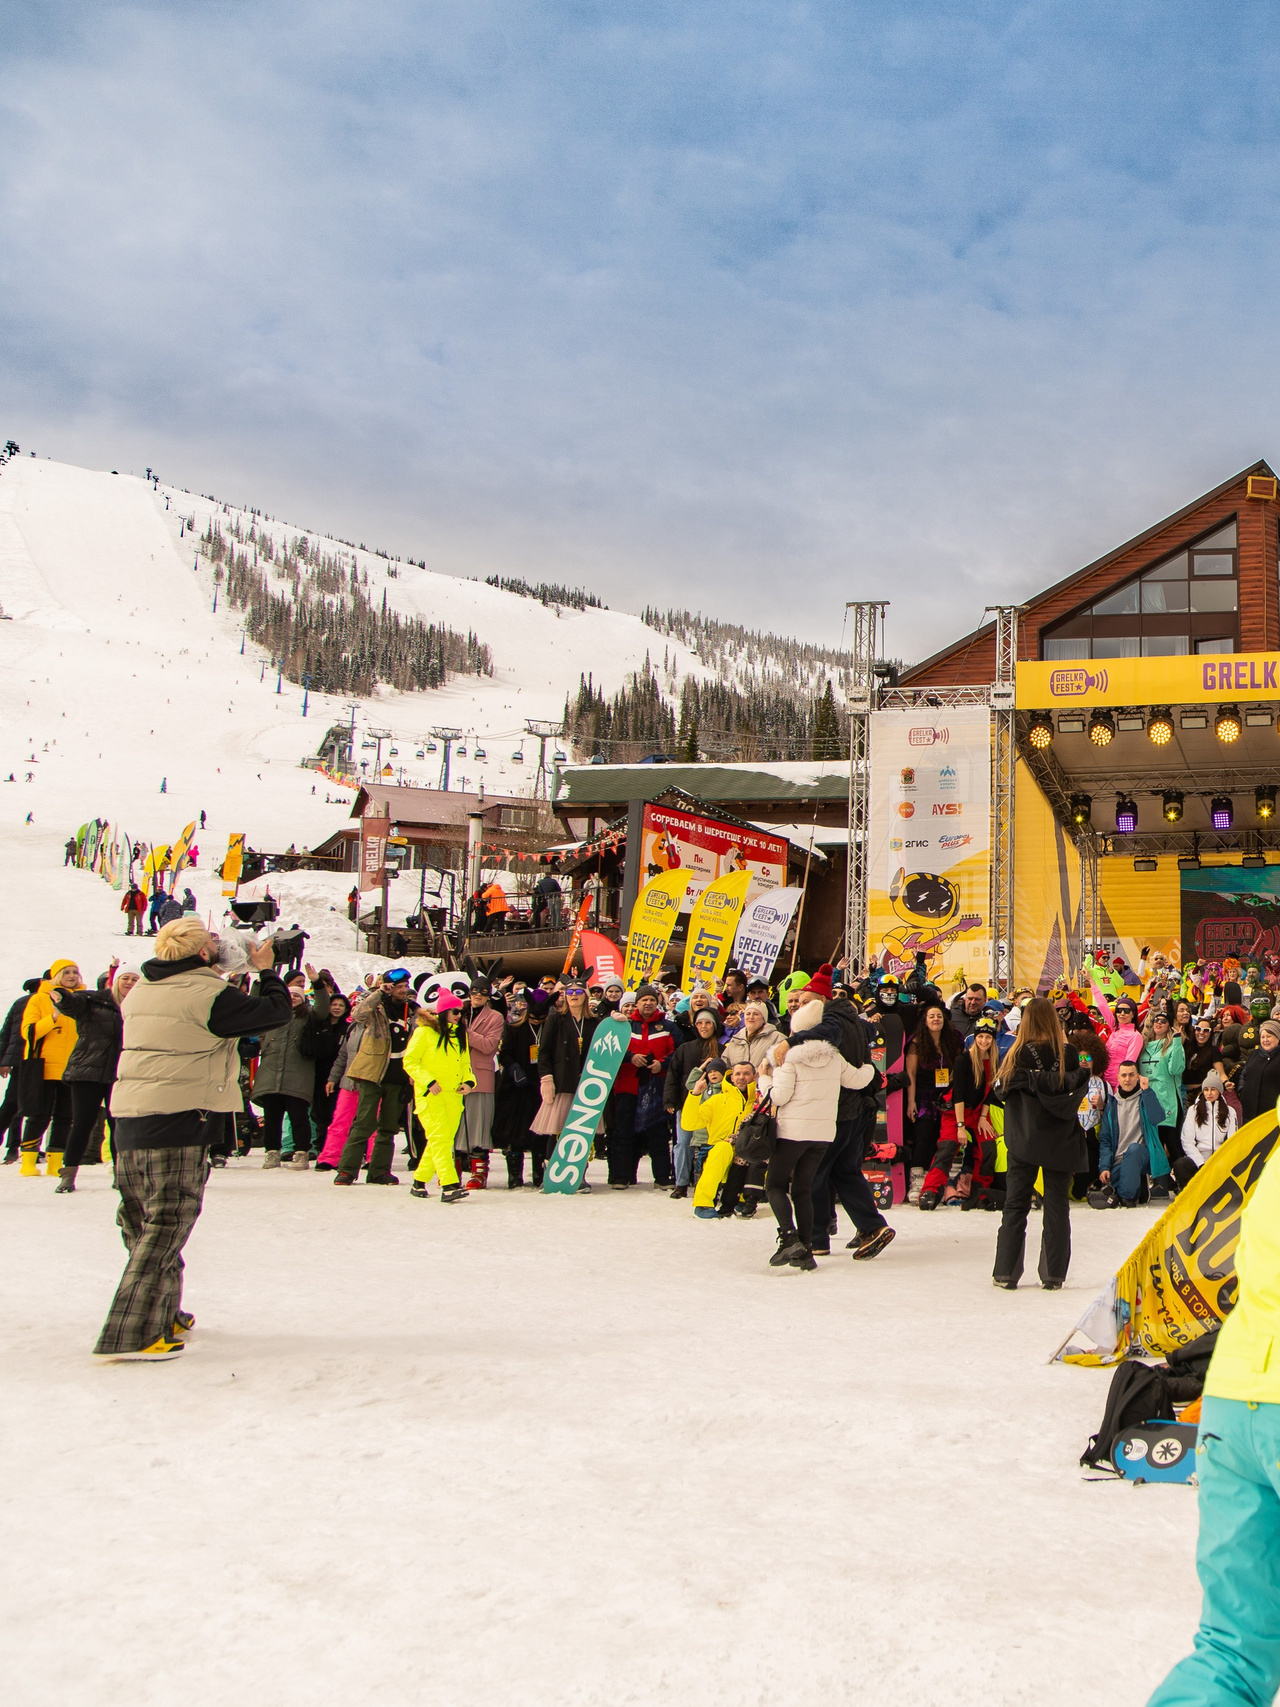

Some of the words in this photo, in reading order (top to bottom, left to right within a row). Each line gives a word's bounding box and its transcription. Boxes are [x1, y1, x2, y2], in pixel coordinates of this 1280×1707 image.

[1055, 672, 1084, 682] GRELKA
[1055, 683, 1074, 693] FEST
[932, 803, 963, 815] AYS!
[650, 812, 696, 832] СОГРЕВАЕМ
[698, 824, 703, 833] В
[704, 826, 742, 843] ШЕРЕГЕШЕ
[743, 836, 758, 848] УЖЕ
[760, 841, 767, 850] 10
[767, 844, 783, 854] ЛЕТ!
[905, 840, 929, 848] 2ГИС
[366, 836, 380, 872] GRELKA
[1205, 923, 1253, 940] GRELKA
[632, 931, 667, 953] GRELKA
[739, 936, 779, 957] GRELKA
[1206, 941, 1239, 957] FEST
[628, 948, 660, 972] FEST
[1181, 1284, 1191, 1296] В
[1188, 1295, 1217, 1330] ГОРЫ
